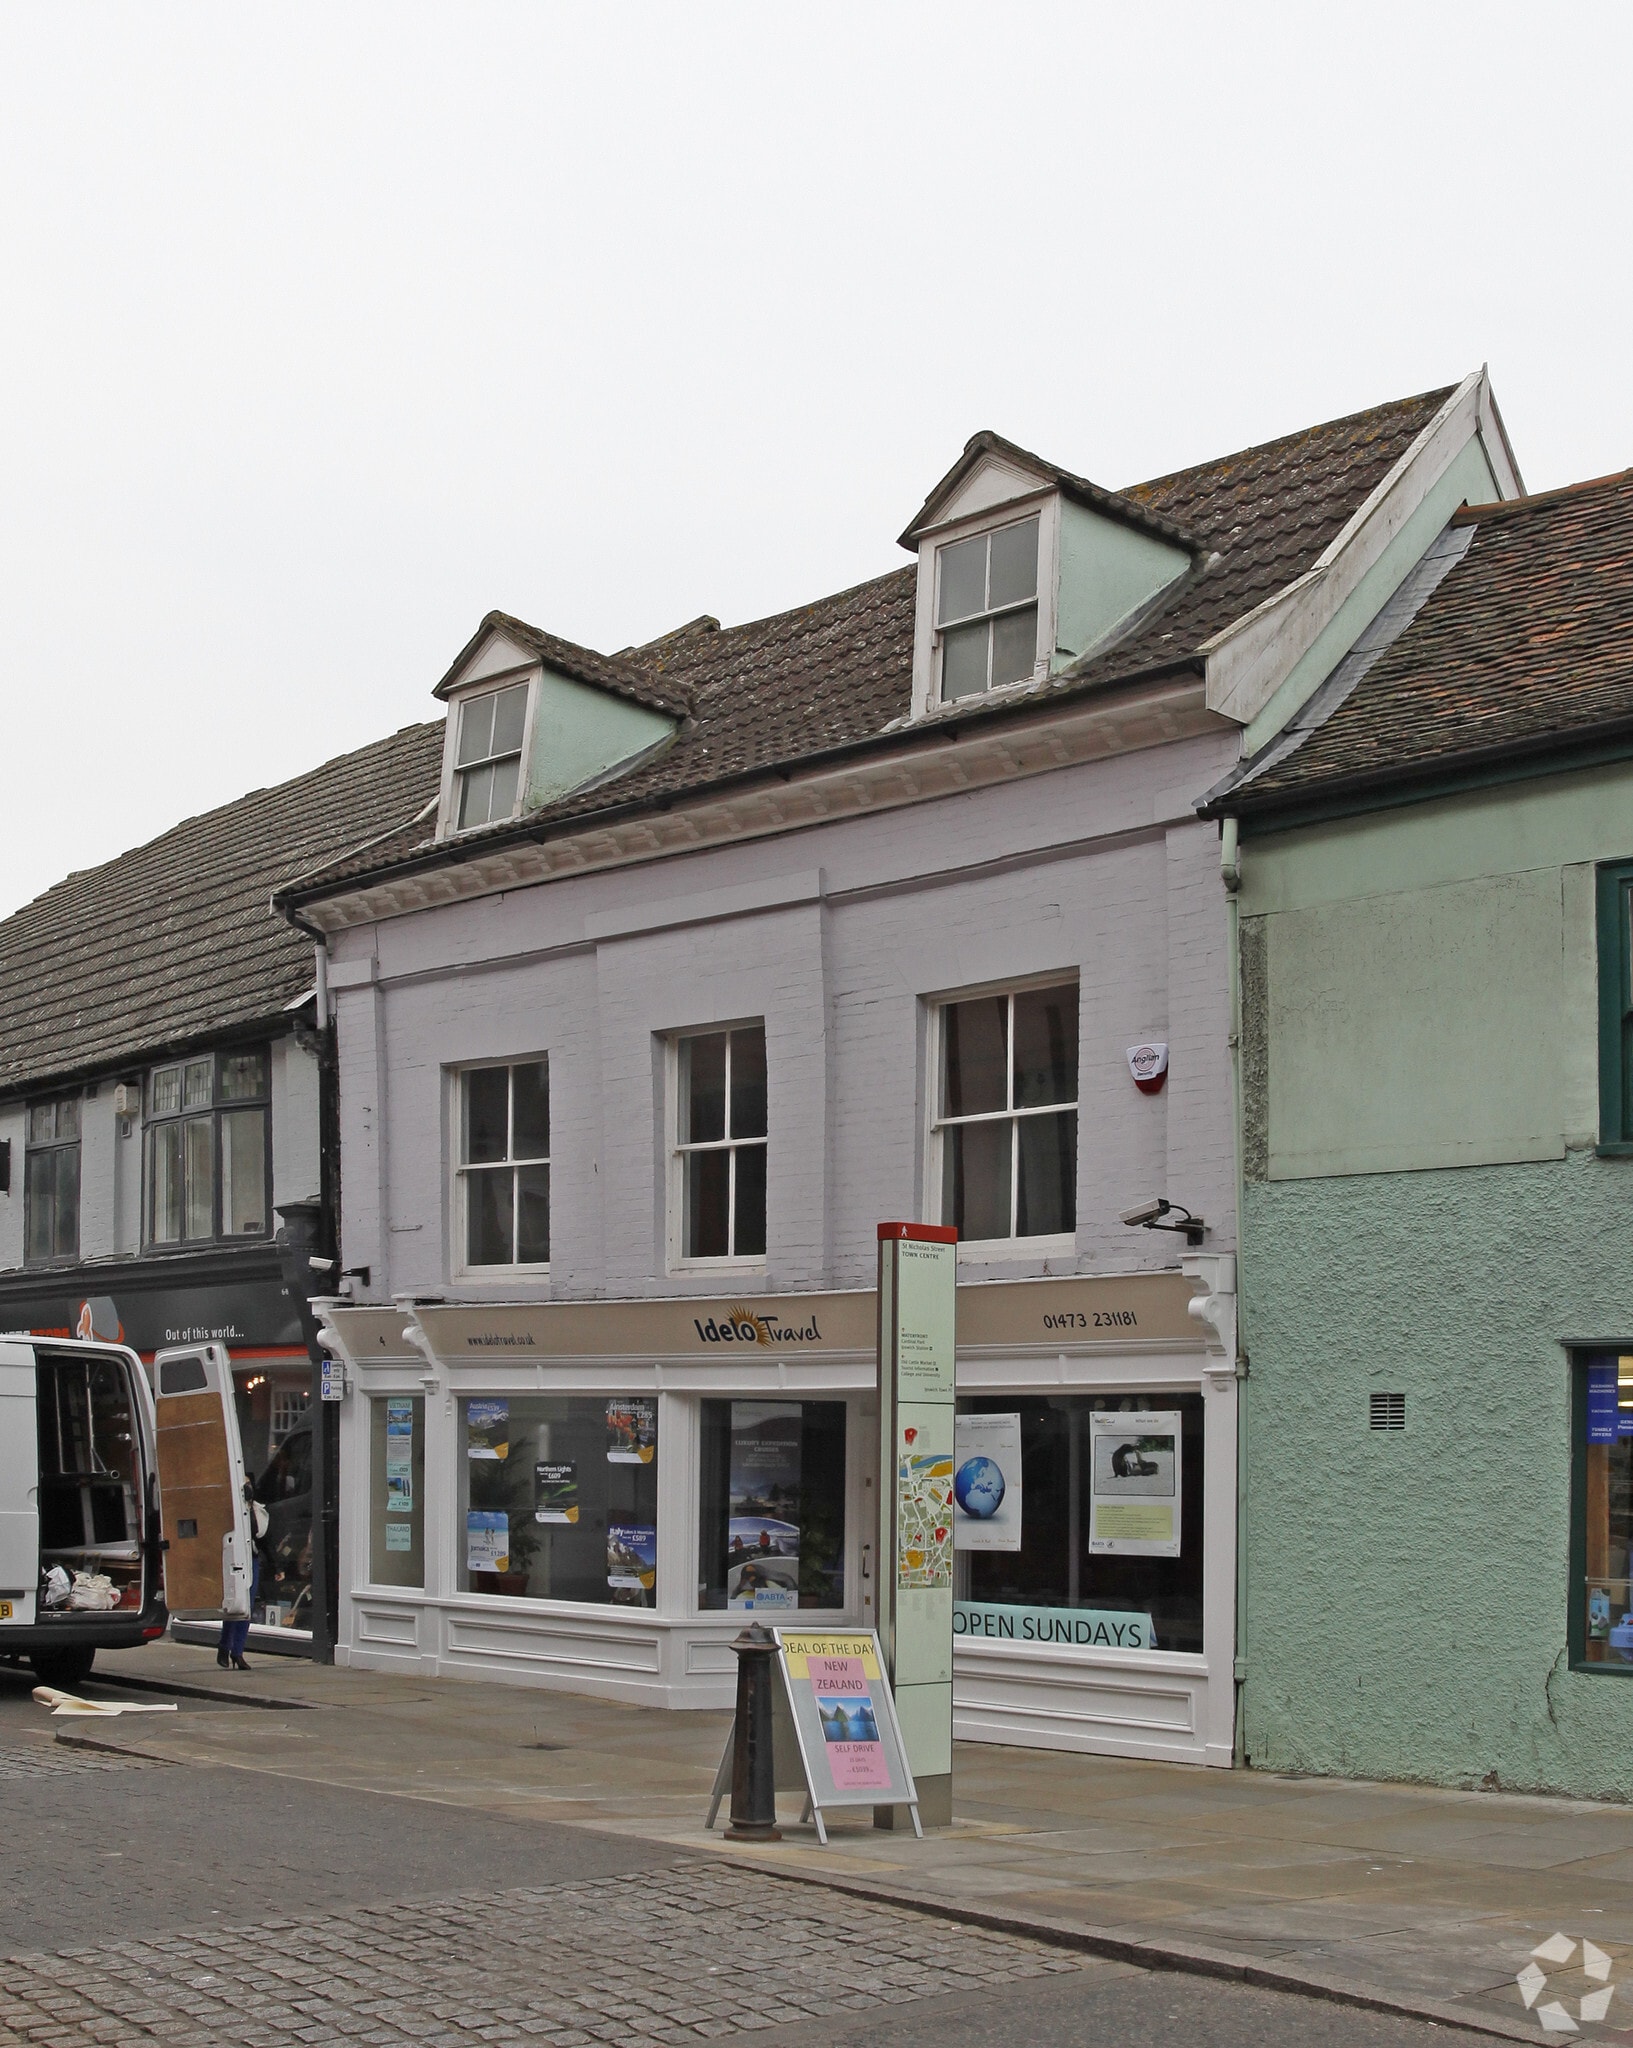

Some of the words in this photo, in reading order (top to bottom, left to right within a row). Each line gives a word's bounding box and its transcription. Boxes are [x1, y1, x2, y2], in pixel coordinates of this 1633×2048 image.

[919, 1252, 939, 1260] CENTRE
[1043, 1313, 1087, 1329] 01473
[1092, 1311, 1138, 1327] 231181
[165, 1328, 180, 1341] Out
[182, 1327, 191, 1342] of
[192, 1326, 209, 1340] this
[210, 1325, 245, 1339] world...
[694, 1317, 757, 1342] Idelo
[757, 1315, 822, 1342] Travel
[379, 1336, 386, 1347] 4
[557, 1466, 572, 1474] Lights
[610, 1527, 624, 1537] Italy
[764, 1593, 786, 1601] ABTA
[953, 1611, 1014, 1639] OPEN
[1022, 1616, 1142, 1649] SUNDAYS
[812, 1642, 828, 1654] OF
[828, 1643, 851, 1655] THE
[853, 1643, 874, 1655] DAY
[824, 1660, 848, 1672] NEW
[816, 1679, 863, 1690] ZEALAND
[835, 1744, 851, 1753] SELF
[852, 1744, 876, 1753] DRIVE
